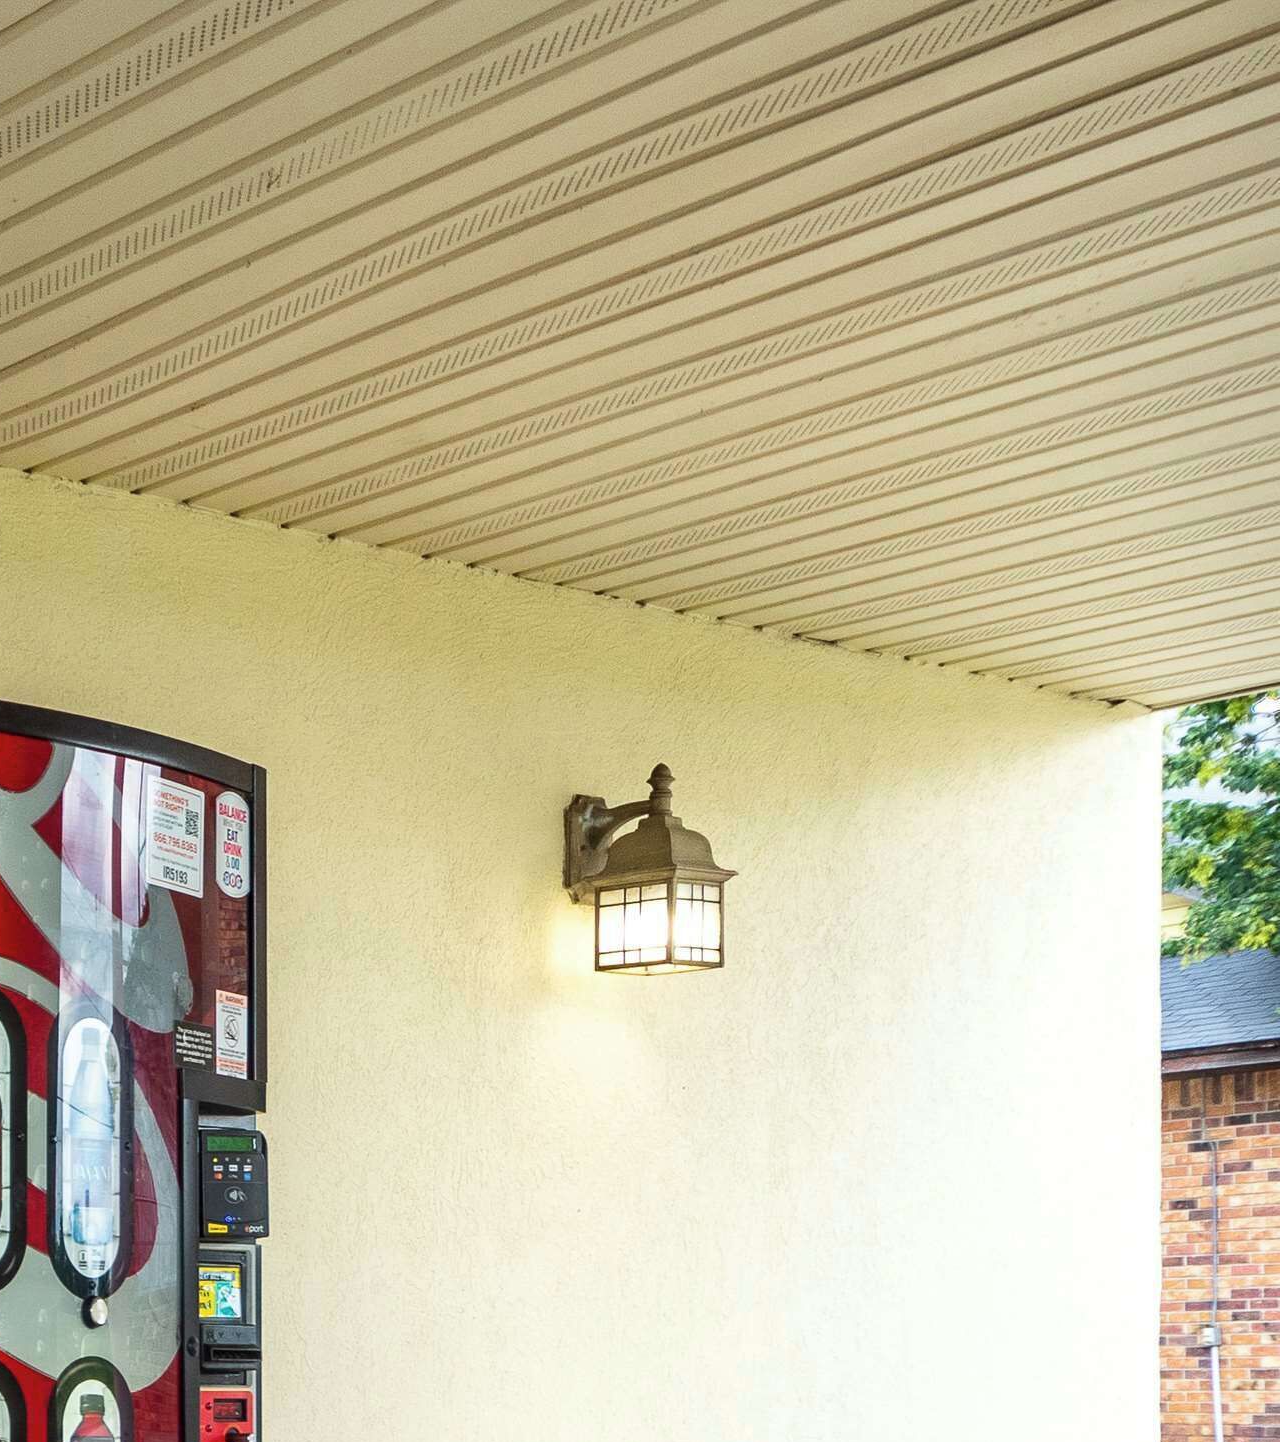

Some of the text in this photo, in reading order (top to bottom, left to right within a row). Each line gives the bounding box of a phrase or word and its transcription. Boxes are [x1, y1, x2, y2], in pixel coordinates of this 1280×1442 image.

[219, 803, 247, 823] BALANCE
[227, 829, 238, 842] EAT
[224, 841, 242, 858] DRINK
[163, 865, 188, 885] IR5193
